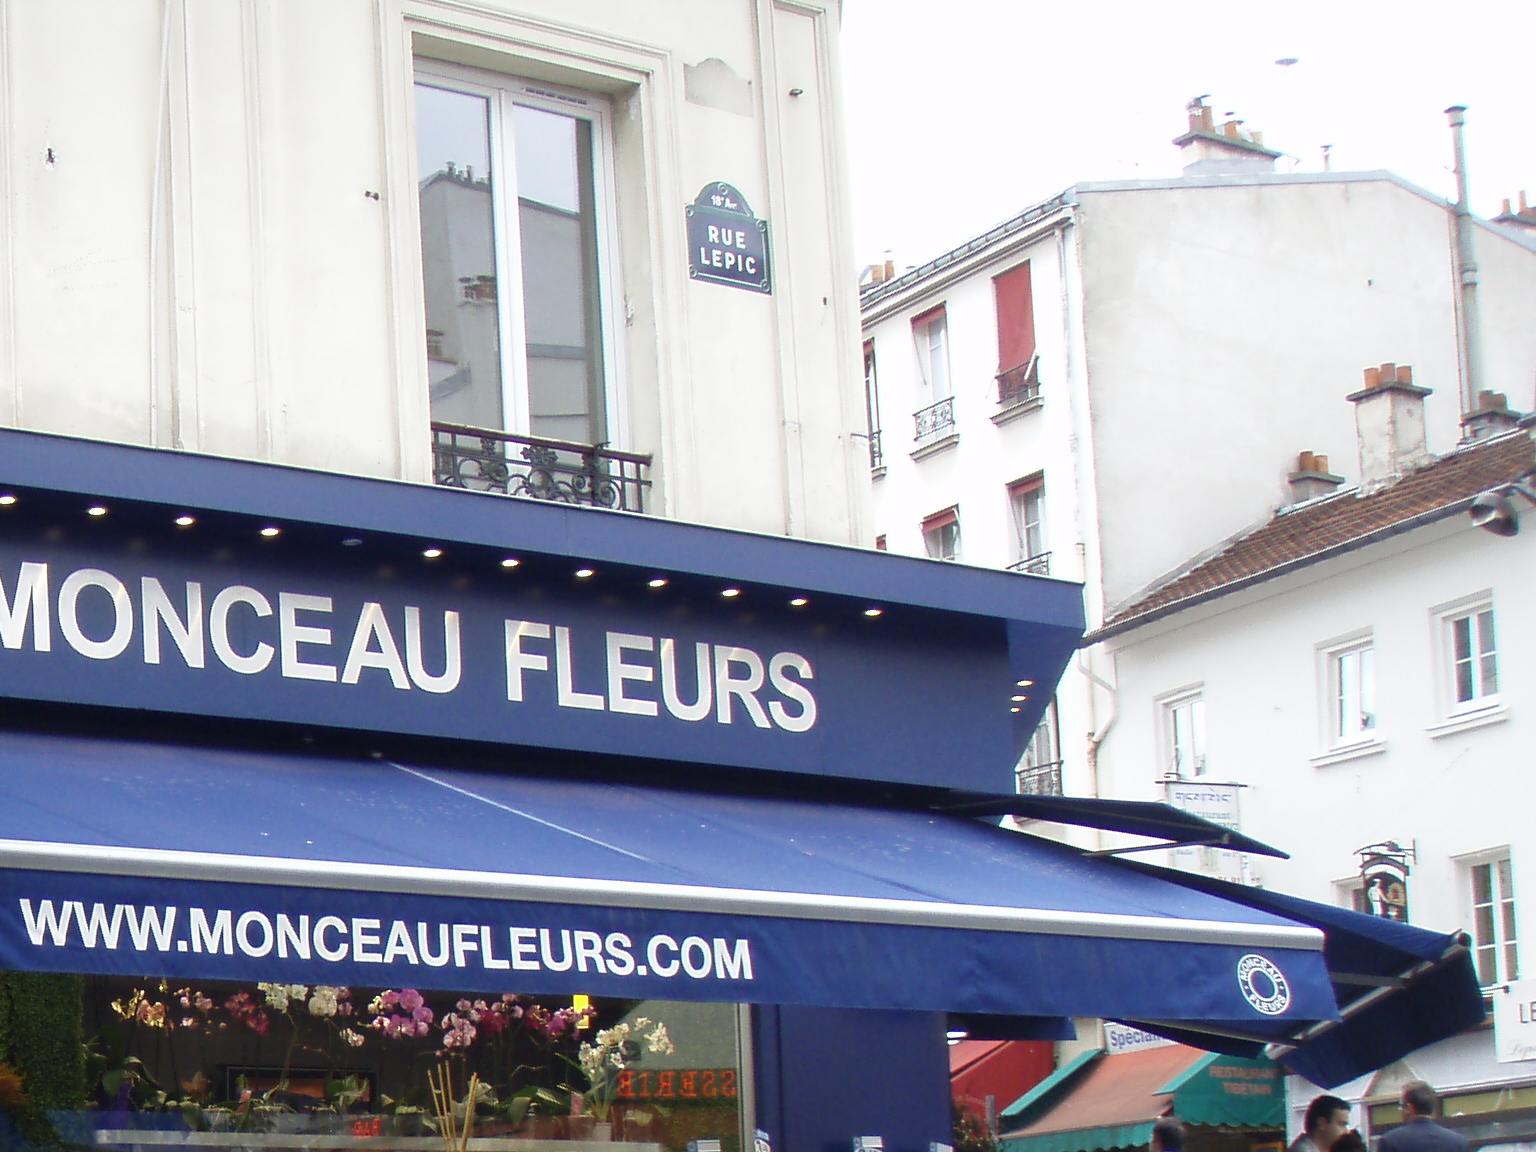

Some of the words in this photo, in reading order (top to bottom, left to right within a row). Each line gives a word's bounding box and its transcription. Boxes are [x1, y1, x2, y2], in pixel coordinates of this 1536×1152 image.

[707, 225, 747, 250] RUE
[700, 246, 757, 275] LEPIC
[503, 617, 819, 733] FLEURS
[19, 897, 755, 982] WWW.MONCEAUFLEURS.COM
[1239, 957, 1283, 983] MONCEAU
[1248, 994, 1287, 1013] FLEURS
[1209, 1065, 1280, 1080] RESTAURANT
